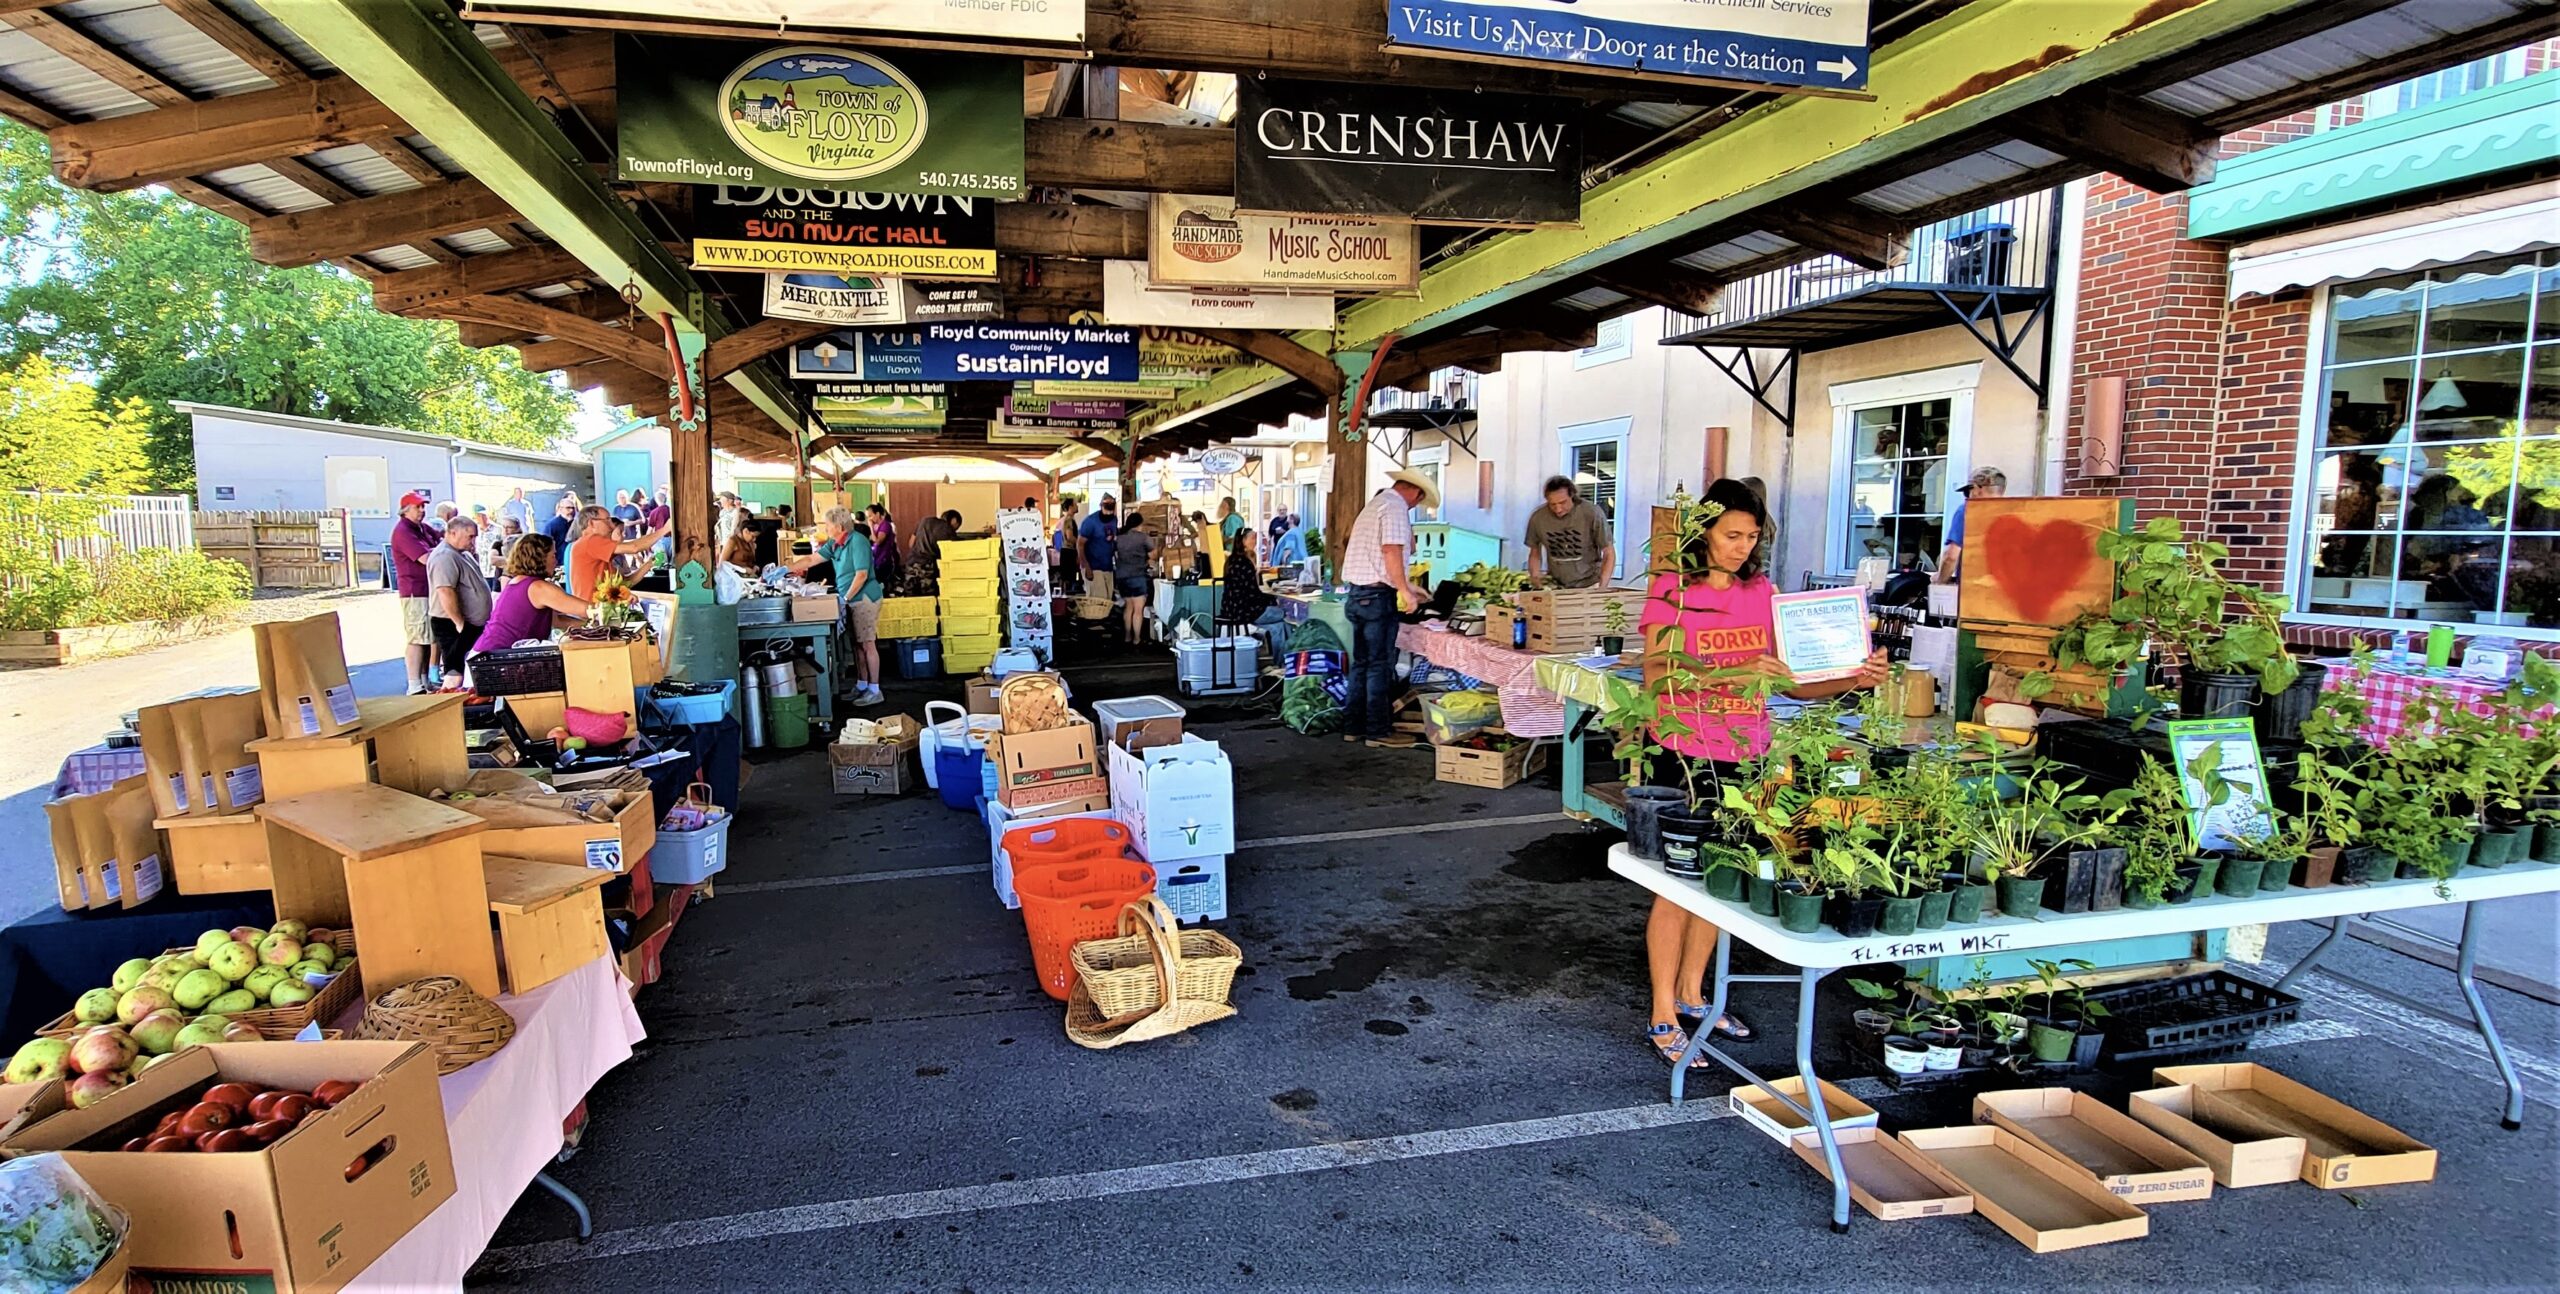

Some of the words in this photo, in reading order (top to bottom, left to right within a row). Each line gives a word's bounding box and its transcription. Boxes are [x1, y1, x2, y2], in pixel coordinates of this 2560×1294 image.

[1011, 0, 1047, 12] FDIC
[1771, 0, 1833, 18] Services
[1401, 7, 1463, 40] Visit
[1470, 19, 1503, 43] Us
[1509, 19, 1575, 52] Next
[1581, 26, 1647, 60] Door
[1654, 42, 1677, 62] at
[1683, 40, 1719, 65] the
[1725, 43, 1806, 76] Station
[817, 90, 878, 108] TOWN
[884, 94, 902, 114] of
[787, 109, 897, 144] FLOYD
[1256, 107, 1567, 164] CRENSHAW
[807, 143, 876, 165] Virginia
[626, 157, 754, 181] TownofFloyd.org
[919, 172, 1018, 191] 540.745.2565
[762, 208, 796, 220] AND
[800, 209, 833, 221] THE
[1172, 227, 1243, 243] HANDMADE
[703, 246, 986, 270] WWW.DOGTOWNROADHOUSE.COM
[1175, 243, 1203, 258] MUSIC
[1205, 245, 1239, 259] SCHOOL
[1263, 268, 1397, 281] HandmadeMusicSchool.com
[780, 285, 889, 307] MERCANTILE
[928, 291, 951, 301] COME
[952, 290, 966, 299] SEE
[967, 290, 978, 298] US
[1191, 298, 1219, 308] FLOYD
[1220, 299, 1255, 309] COUNTY
[915, 304, 945, 315] ACROSS
[947, 303, 962, 313] THE
[962, 302, 993, 313] STREET!
[930, 326, 974, 341] Floyd
[978, 327, 1070, 344] Community
[1075, 329, 1130, 344] Market
[1009, 343, 1042, 352] Operated
[1043, 344, 1053, 353] by
[887, 366, 911, 374] FLOYD
[956, 353, 1110, 378] SustainFloyd
[816, 383, 831, 393] Visit
[832, 385, 840, 393] us
[841, 385, 861, 393] across
[863, 383, 873, 393] the
[874, 383, 892, 393] street
[894, 383, 909, 393] from
[911, 383, 921, 393] the
[922, 383, 945, 393] Market!
[1012, 417, 1033, 426] Signs
[1046, 419, 1078, 428] Banners
[1091, 419, 1117, 428] Decals
[1785, 607, 1806, 618] HOLY
[1807, 606, 1831, 616] BASIL
[1832, 603, 1854, 613] BOOK
[1700, 629, 1764, 650] SORRY
[1021, 773, 1041, 785] USA
[1851, 945, 1880, 962] FL.
[1887, 941, 1944, 957] FARM
[2332, 1162, 2351, 1182] G
[2137, 1183, 2167, 1193] ZERO
[2167, 1179, 2205, 1191] SUGAR
[153, 1280, 249, 1294] TOMATOES
